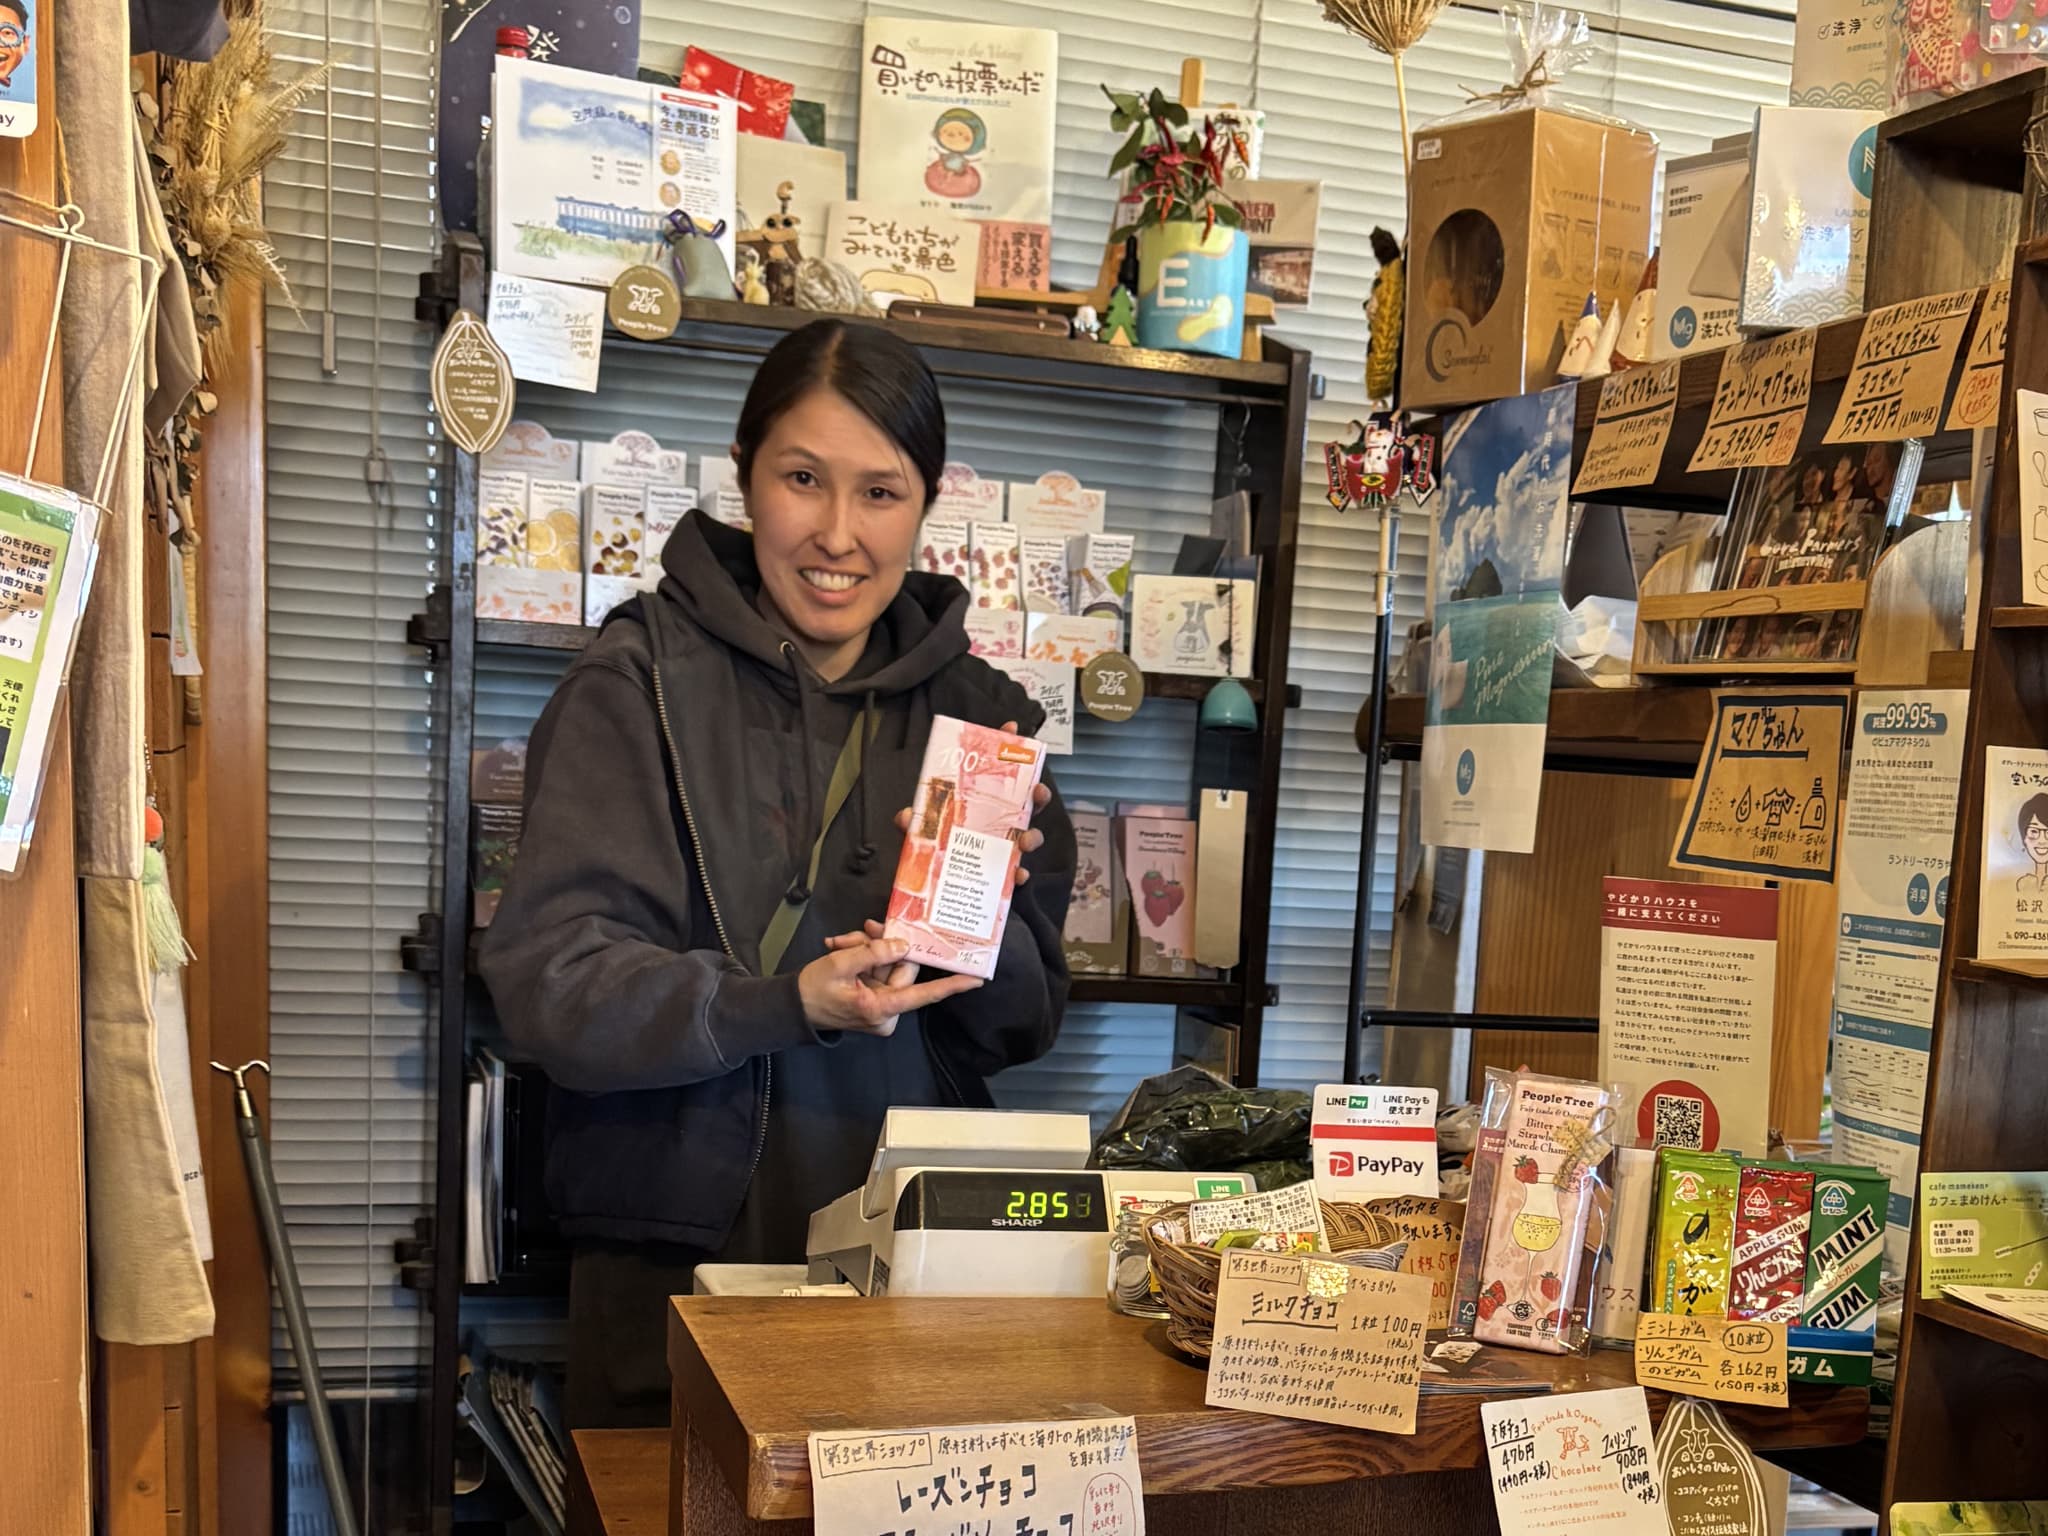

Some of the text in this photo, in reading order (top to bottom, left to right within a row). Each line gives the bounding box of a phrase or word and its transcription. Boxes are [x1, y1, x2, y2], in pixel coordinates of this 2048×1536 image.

[871, 45, 1045, 96] 買いものは投票なんだ
[848, 216, 960, 249] こどもたちが
[842, 239, 957, 273] みている景色
[1731, 707, 1804, 749] マグちゃん
[1607, 893, 1698, 908] やどかりハウスを
[1606, 907, 1721, 924] 一緒に支えてください
[1326, 1098, 1366, 1107] LINE Pay
[1383, 1095, 1402, 1103] LINE
[1521, 1090, 1594, 1108] People Tree
[1388, 1106, 1421, 1115] 使えます
[1526, 1117, 1554, 1130] Bitter
[1507, 1138, 1529, 1150] Marc
[1529, 1141, 1539, 1151] de
[1358, 1156, 1424, 1176] PayPay
[992, 1218, 1042, 1227] SHARP
[1738, 1220, 1806, 1261] APPLE GUM
[1814, 1209, 1878, 1272] MINT
[1251, 1291, 1338, 1320] ミルクチョコ
[1351, 1315, 1378, 1331] 1粒
[1383, 1315, 1421, 1338] 100円
[1810, 1286, 1868, 1327] GUM
[1729, 1331, 1765, 1347] 10粒
[1720, 1360, 1777, 1379] 各162円
[1788, 1356, 1834, 1378] ガム
[1601, 1425, 1638, 1454] フィリング
[1502, 1441, 1535, 1471] 476円
[1616, 1446, 1648, 1474] 908円
[1671, 1461, 1738, 1478] おいしさのひみつ
[897, 1463, 1036, 1514] レーズンチョコ
[1706, 1494, 1739, 1507] くちどけ
